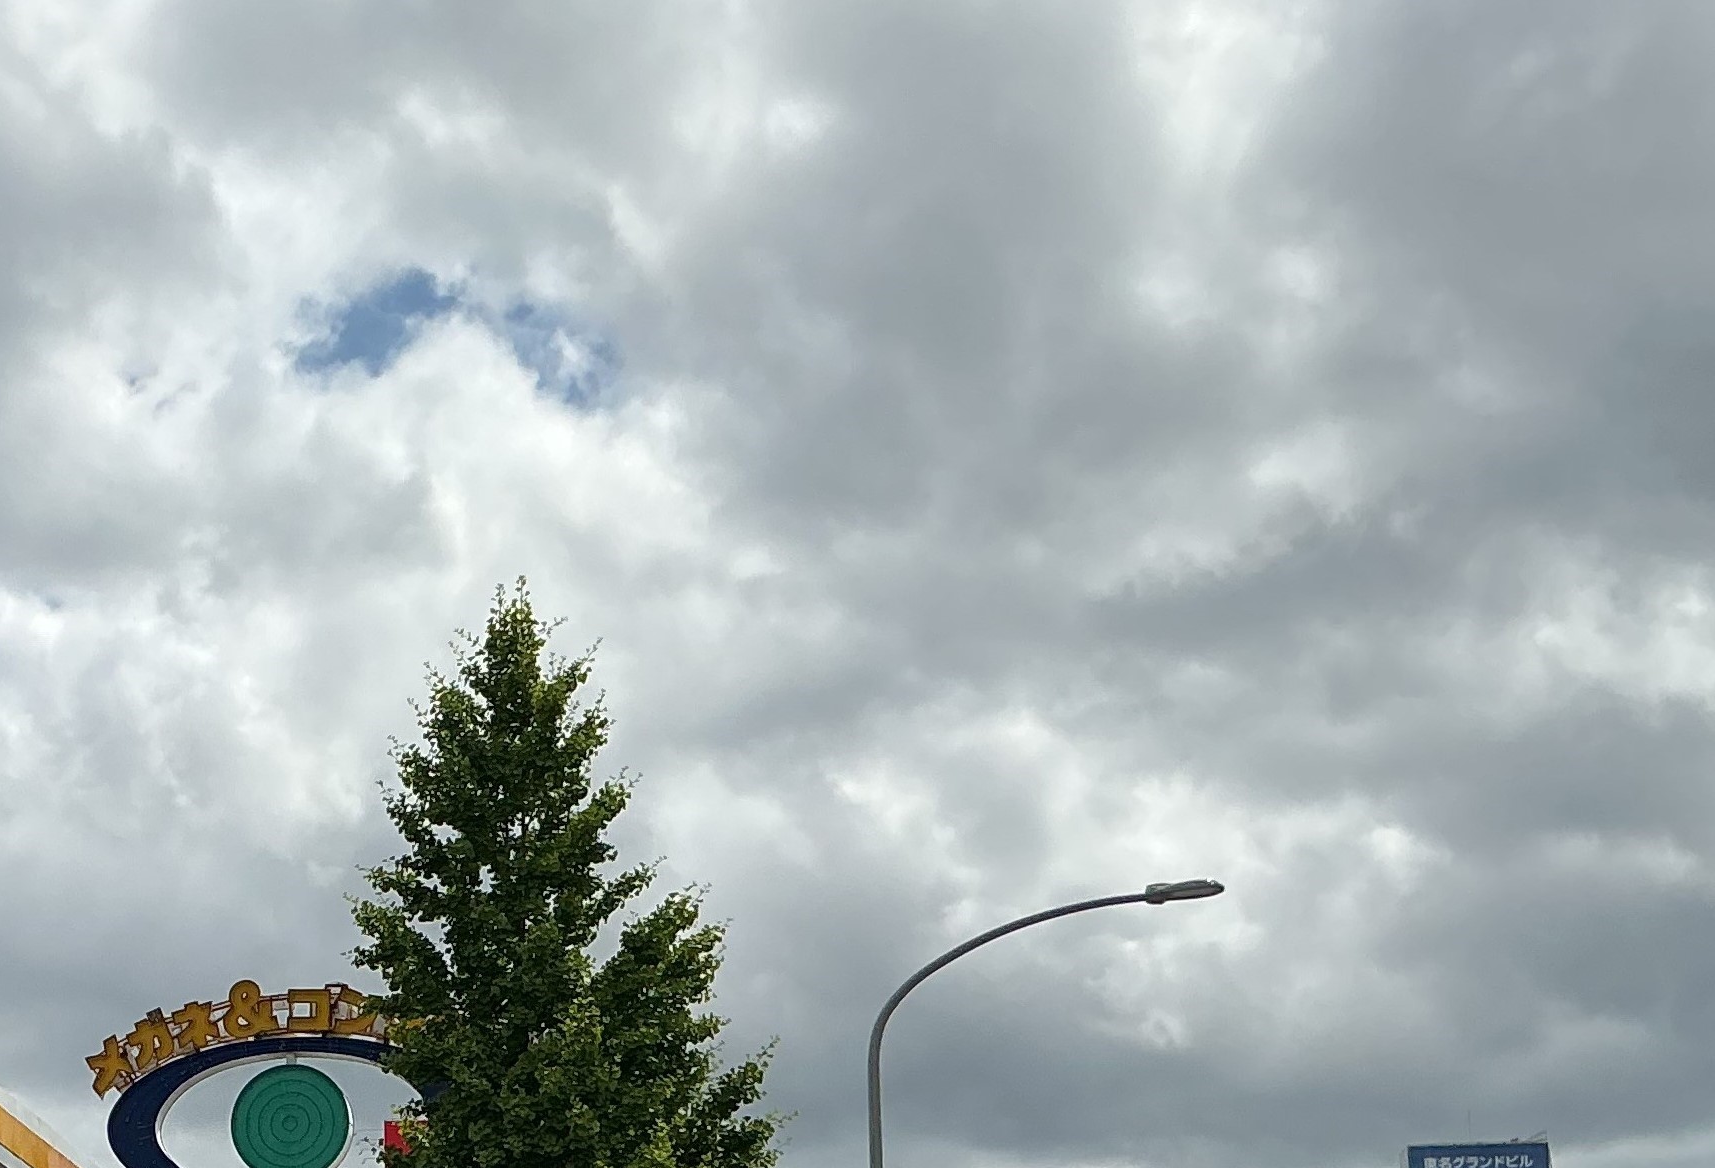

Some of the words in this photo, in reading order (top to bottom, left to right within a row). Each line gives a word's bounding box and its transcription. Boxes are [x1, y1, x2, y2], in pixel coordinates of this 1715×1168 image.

[86, 980, 387, 1100] メガネ&コン
